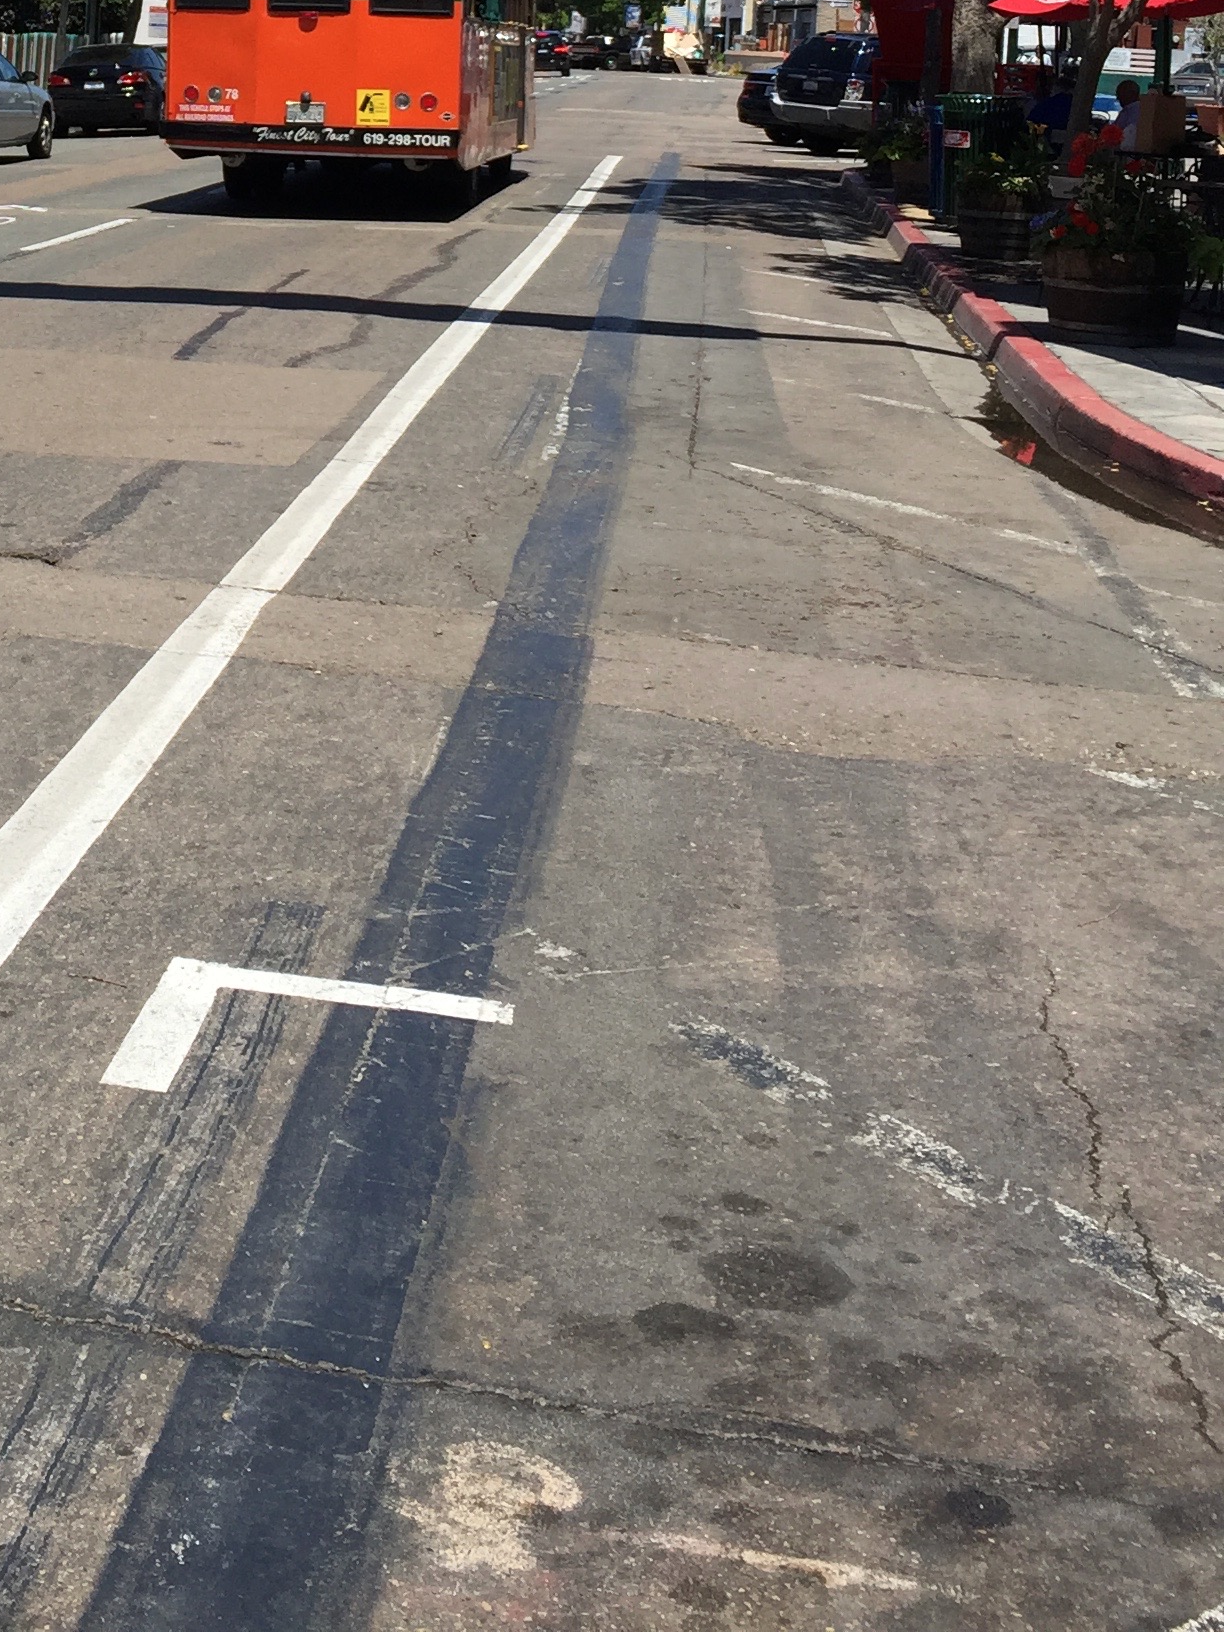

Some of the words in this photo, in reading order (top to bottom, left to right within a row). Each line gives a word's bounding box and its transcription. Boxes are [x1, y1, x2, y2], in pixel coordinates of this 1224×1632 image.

[224, 88, 239, 100] 78
[294, 126, 321, 144] City
[363, 132, 451, 147] 619-298-TOUR
